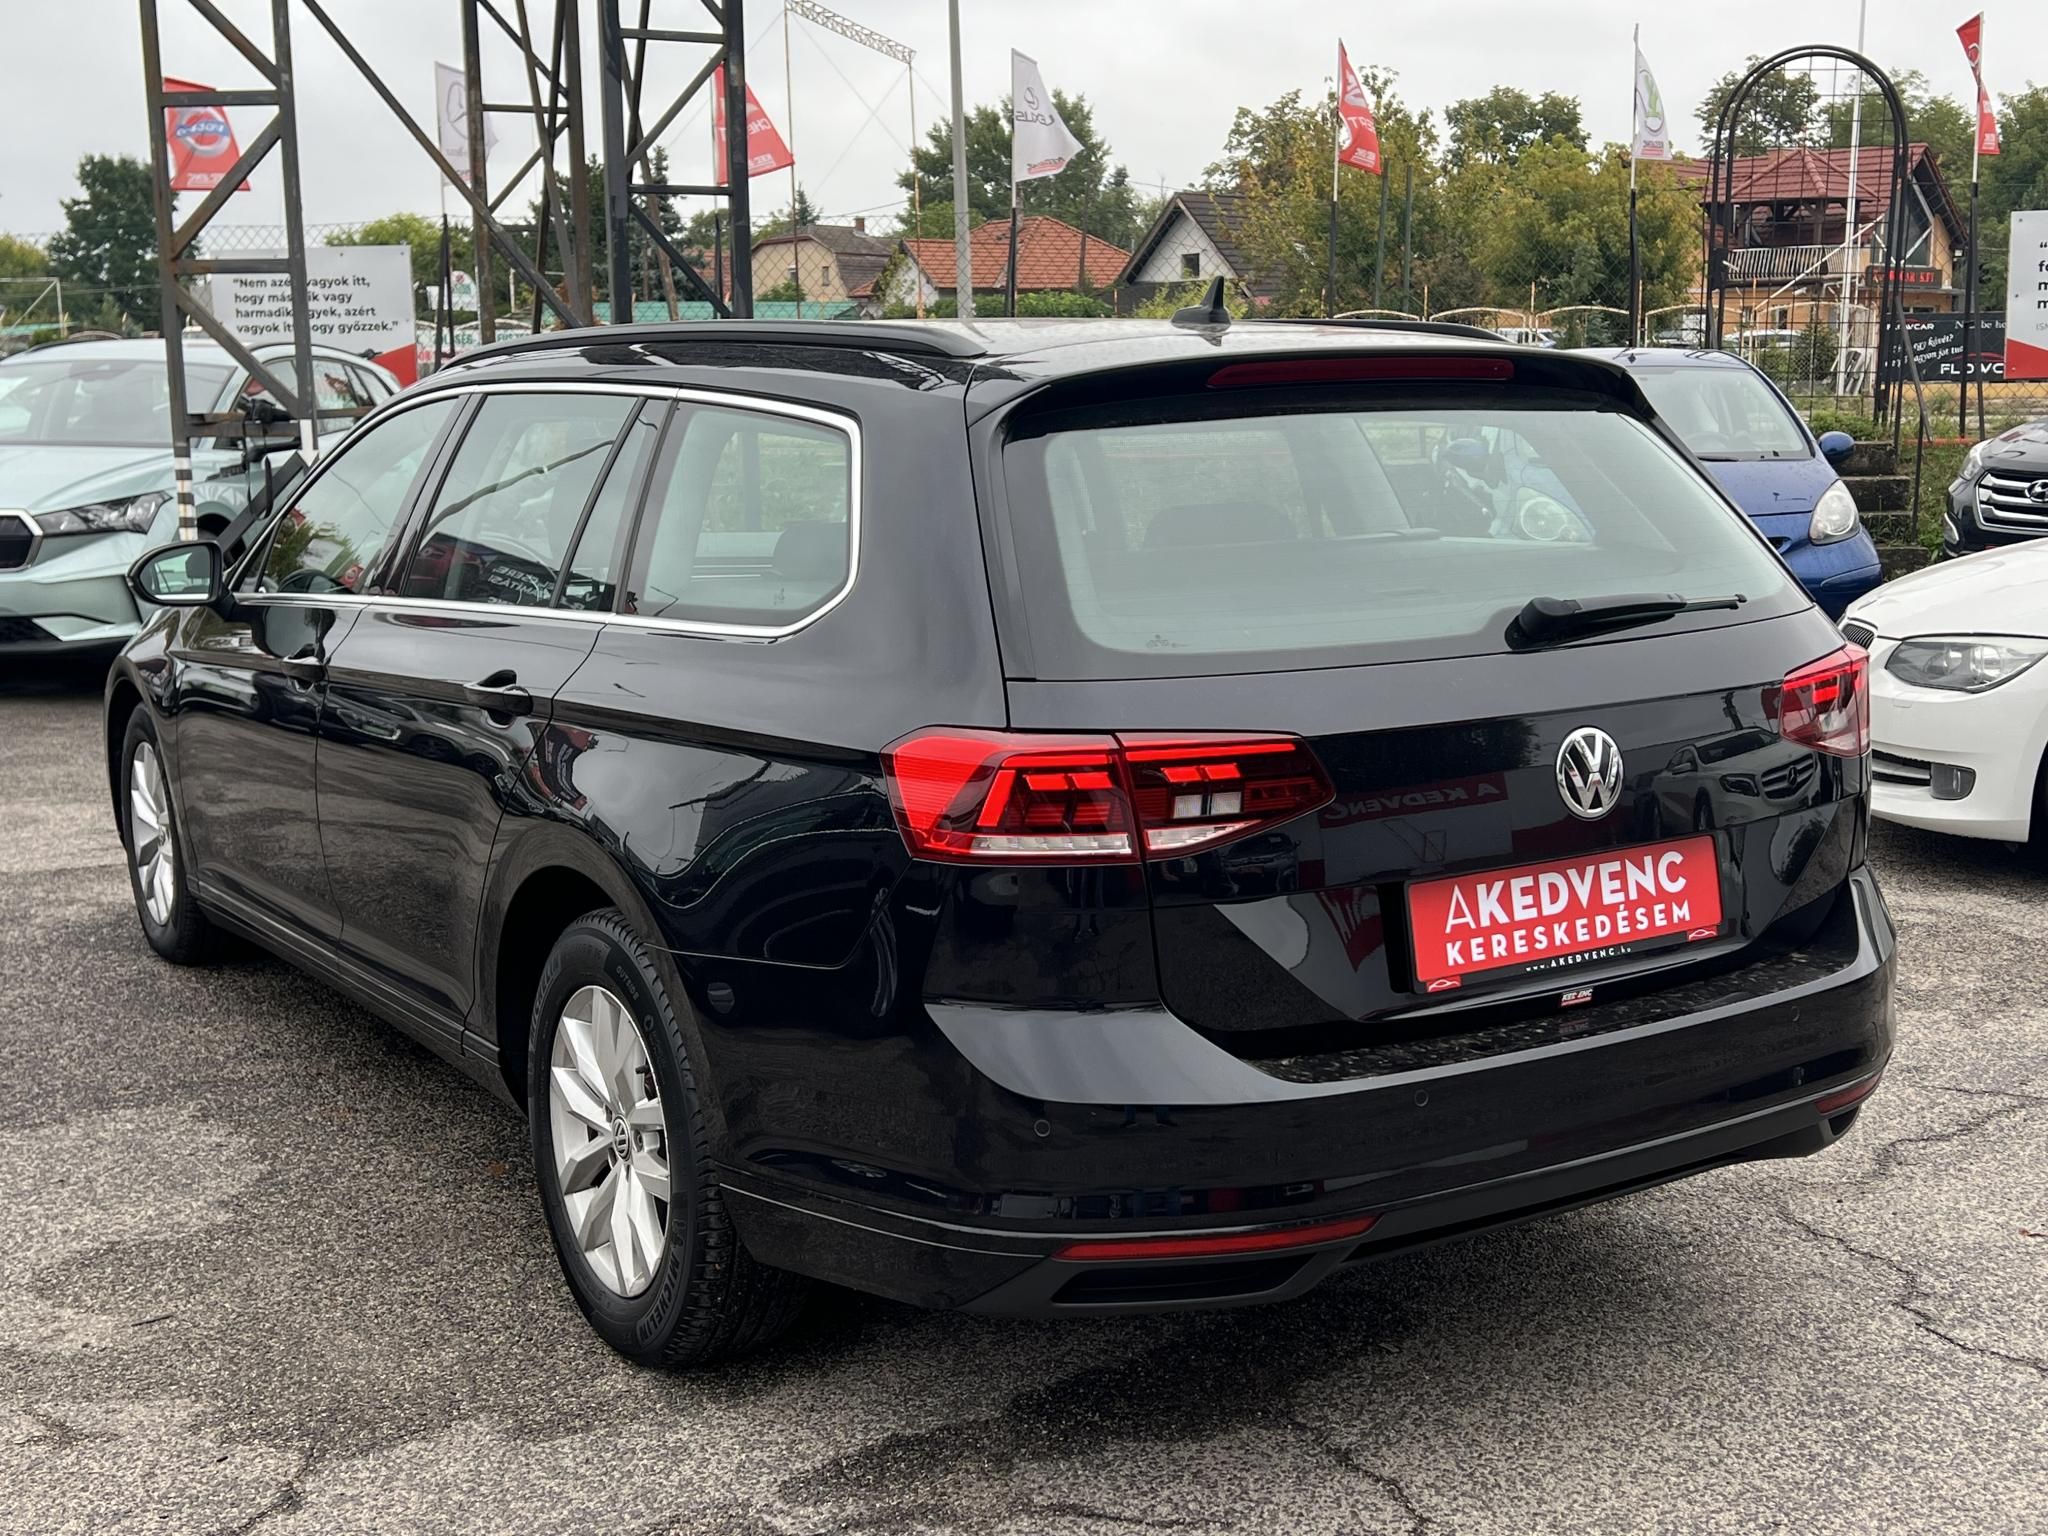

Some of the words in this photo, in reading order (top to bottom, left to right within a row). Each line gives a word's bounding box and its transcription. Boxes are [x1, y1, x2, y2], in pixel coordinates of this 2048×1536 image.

[271, 277, 292, 288] azé
[305, 276, 349, 289] vagyok
[352, 275, 371, 288] itt,
[234, 293, 264, 306] hogy
[268, 292, 320, 303] másik
[323, 293, 353, 305] vagy
[236, 306, 293, 318] harmadik
[344, 307, 376, 317] azért
[237, 323, 279, 335] vagyok
[311, 324, 334, 335] ogy
[1446, 899, 1691, 967] KERESKEDÉSEM
